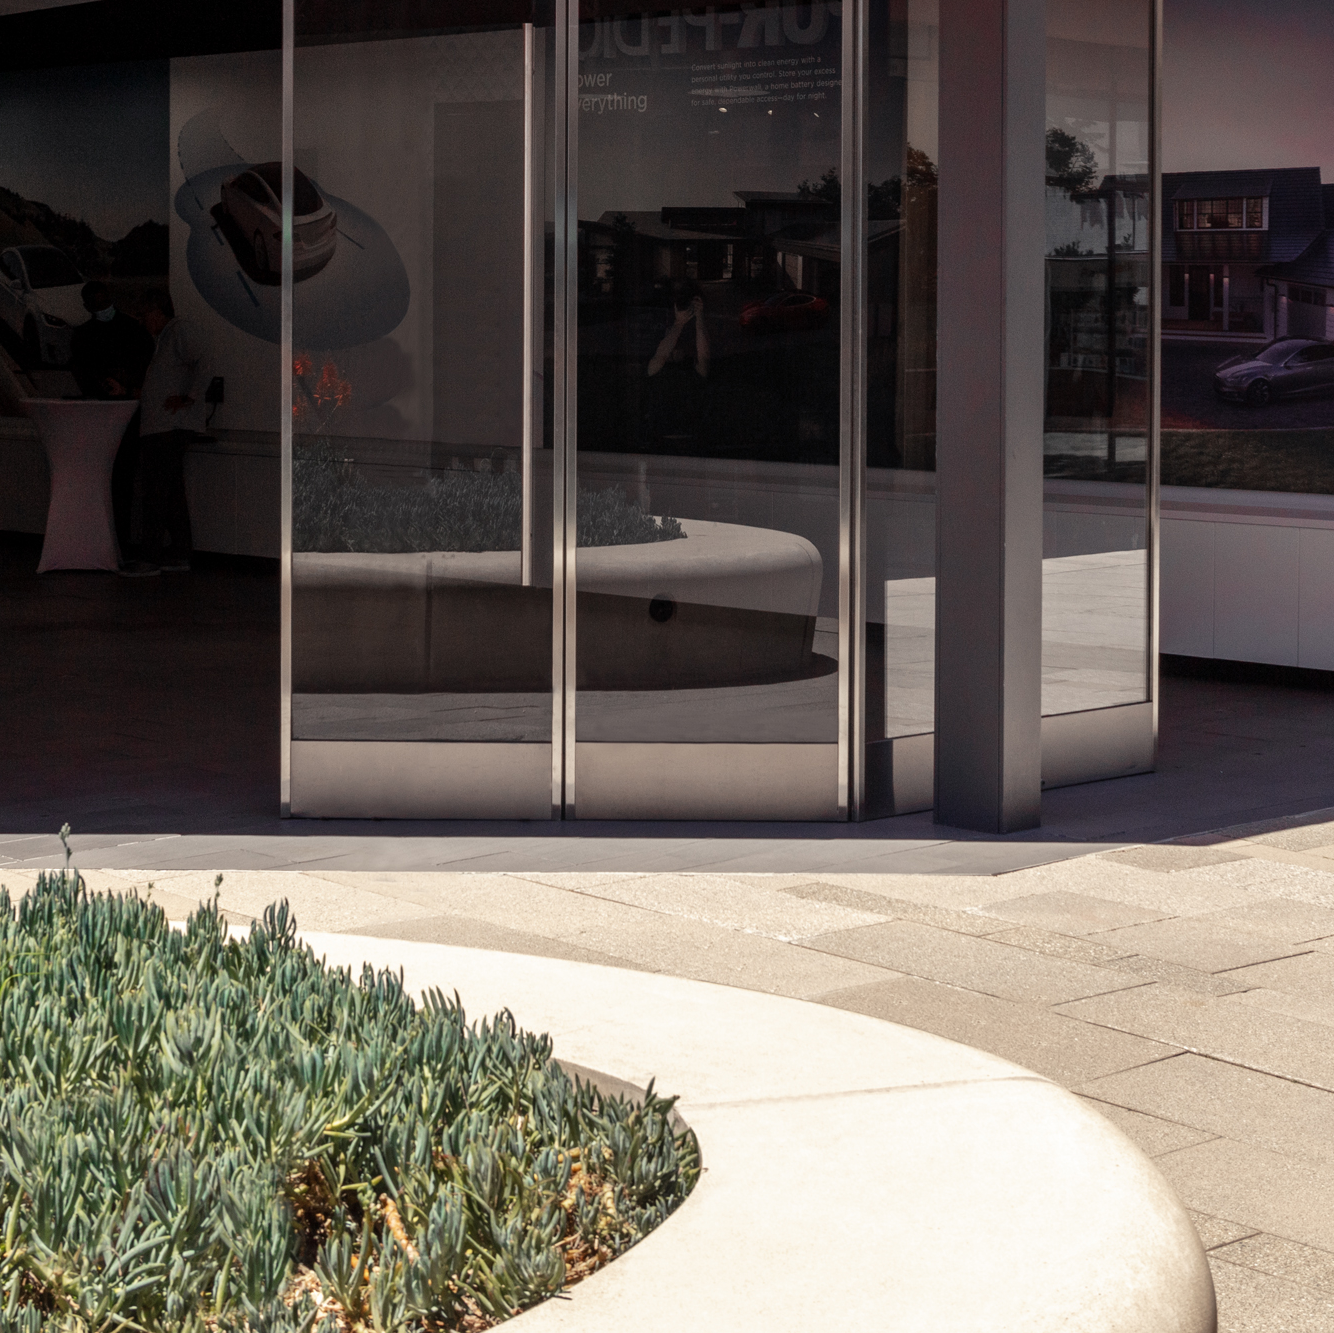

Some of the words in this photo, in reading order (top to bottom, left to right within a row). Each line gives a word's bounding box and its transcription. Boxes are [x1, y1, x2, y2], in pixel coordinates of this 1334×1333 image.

[691, 62, 716, 72] Convert
[717, 60, 741, 71] sunlight
[744, 60, 756, 68] into
[757, 59, 775, 67] clean
[776, 57, 799, 67] energy
[800, 56, 816, 64] with
[577, 72, 613, 88] ower
[691, 74, 718, 84] personal
[719, 73, 737, 83] utility
[738, 73, 751, 82] you
[752, 70, 776, 79] control.
[778, 70, 796, 78] Store
[797, 69, 813, 78] your
[814, 67, 837, 76] excess
[691, 88, 713, 97] energy
[714, 85, 728, 94] with
[770, 82, 789, 90] home
[790, 80, 815, 90] battery
[691, 98, 700, 107] for
[702, 98, 716, 107] safe,
[717, 96, 755, 106] dependable
[796, 91, 806, 100] for
[807, 91, 827, 101] night.
